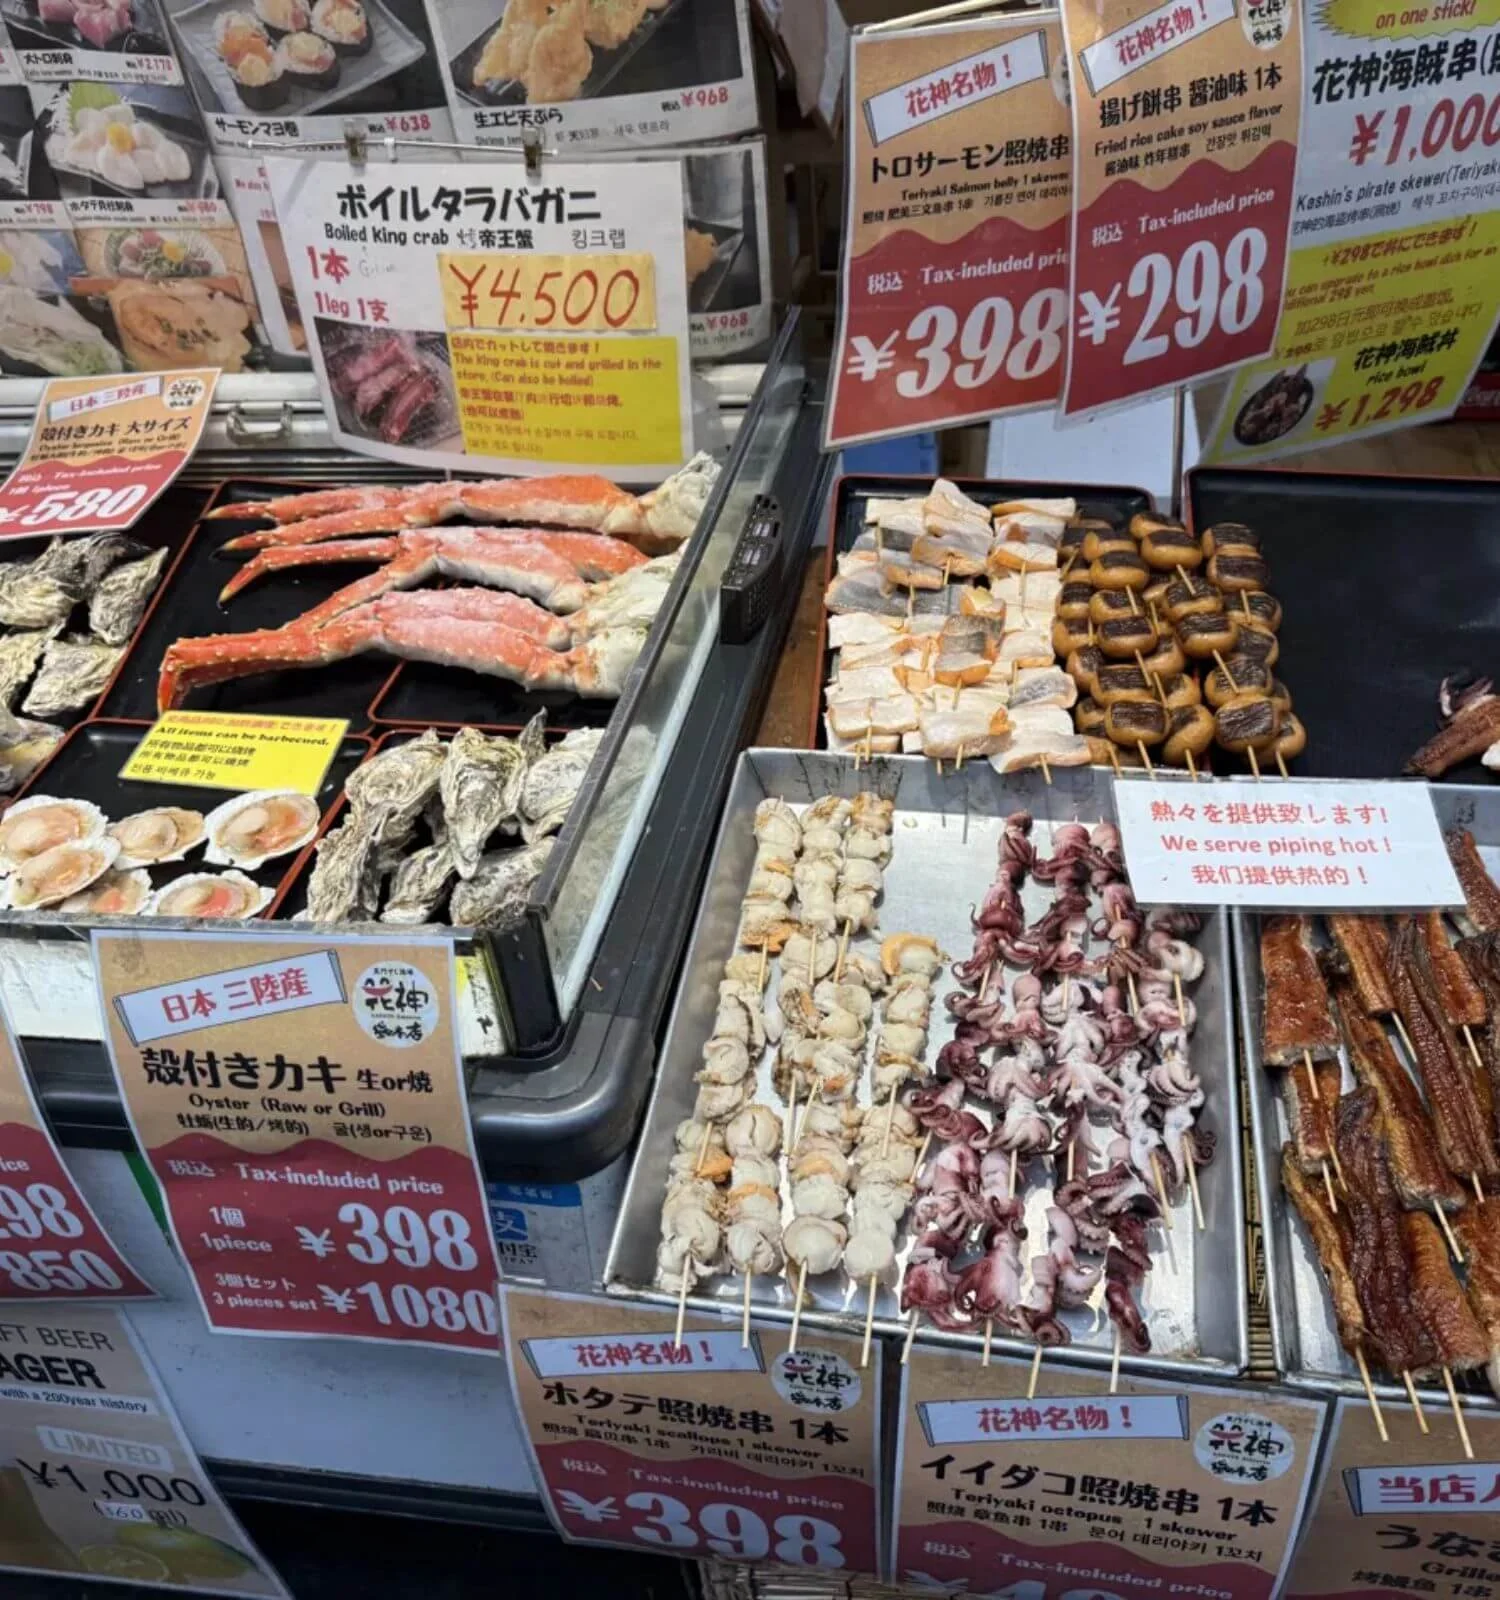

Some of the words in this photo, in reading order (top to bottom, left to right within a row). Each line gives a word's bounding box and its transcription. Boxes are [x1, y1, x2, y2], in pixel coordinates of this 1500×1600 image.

[1375, 13, 1396, 30] on
[1400, 11, 1428, 26] one
[474, 107, 563, 129] 生エビ天ぷら
[681, 87, 729, 107] ¥968
[1099, 85, 1183, 129] 揚げ餅串
[1188, 68, 1249, 108] 醤油味
[1254, 61, 1283, 91] 1本
[385, 114, 431, 132] ¥638
[1094, 140, 1128, 158] Fried
[1130, 134, 1154, 149] rice
[1156, 125, 1186, 143] cake
[1187, 120, 1208, 138] soy
[1211, 113, 1246, 131] sauce
[1248, 103, 1284, 121] flavor
[872, 134, 1070, 184] トロサーモン照焼串
[337, 186, 602, 223] ボイルタラバガニ
[901, 185, 948, 202] Teriyaki
[949, 182, 991, 196] Salmon
[1356, 180, 1397, 205] pirate
[1138, 194, 1236, 235] Tax-included
[1238, 187, 1276, 213] price
[324, 223, 368, 242] Boiled
[413, 229, 449, 246] crab
[478, 228, 534, 250] 帝王蟹
[572, 228, 626, 250] 킹크랩
[1091, 222, 1124, 248] 税込
[307, 246, 350, 284] 1本
[921, 251, 1034, 285] Tax-included
[867, 271, 904, 295] 税込
[1077, 226, 1269, 366] ¥298
[358, 298, 390, 323] 1支
[705, 312, 749, 331] ¥968
[846, 287, 1070, 399] ¥398
[453, 353, 475, 366] The
[643, 357, 663, 370] the
[40, 422, 120, 442] 殻付きカキ
[126, 415, 192, 435] 大サイズ
[215, 731, 240, 739] can
[241, 732, 256, 740] be
[1160, 834, 1198, 852] We
[1204, 837, 1262, 853] serve
[1268, 835, 1336, 858] piping
[1339, 834, 1378, 853] hot
[161, 988, 218, 1025] 日本
[222, 966, 313, 1013] 三陸産
[140, 1047, 347, 1094] 殻付きカキ
[356, 1068, 434, 1094] 生or焼
[189, 1094, 251, 1112] Oyster
[260, 1096, 307, 1116] (Raw
[313, 1103, 333, 1115] or
[338, 1101, 387, 1118] Grill)
[166, 1159, 217, 1179] 税込
[234, 1162, 382, 1191] Tax-included
[387, 1177, 445, 1197] price
[0, 1182, 85, 1239] 98
[209, 1206, 246, 1229] 1個
[200, 1231, 274, 1254] 1piece
[294, 1202, 479, 1272] ¥398
[212, 1291, 225, 1306] 3
[227, 1294, 285, 1312] pieces
[289, 1298, 318, 1311] set
[316, 1280, 498, 1337] ¥1080
[36, 1326, 116, 1353] BEER
[99, 1398, 148, 1414] history
[541, 1381, 775, 1434] ホタテ照焼串
[788, 1417, 849, 1446] 1本
[47, 1431, 162, 1466] LIMITED
[575, 1413, 651, 1435] Teriyaki
[655, 1426, 732, 1447] scallops
[751, 1440, 823, 1460] skewer
[561, 1458, 608, 1477] 税込
[690, 1443, 740, 1462] 가리비
[745, 1450, 815, 1472] 데리야키
[15, 1458, 208, 1507] ¥1,000
[628, 1467, 780, 1502] Tax-included
[786, 1493, 845, 1513] price
[919, 1453, 1201, 1518] イイダコ照焼串
[1215, 1495, 1281, 1529] 1本
[556, 1488, 847, 1570] ¥398
[950, 1487, 1037, 1513] Teriyaki
[1041, 1502, 1124, 1527] octopus
[1159, 1518, 1239, 1543] skewer
[1088, 1524, 1127, 1544] 문어
[1132, 1531, 1209, 1556] 데리야키
[1214, 1543, 1264, 1564] 1꼬치
[998, 1551, 1164, 1592] Tax-included
[1168, 1580, 1235, 1600] price
[1420, 1561, 1500, 1583] Grille
